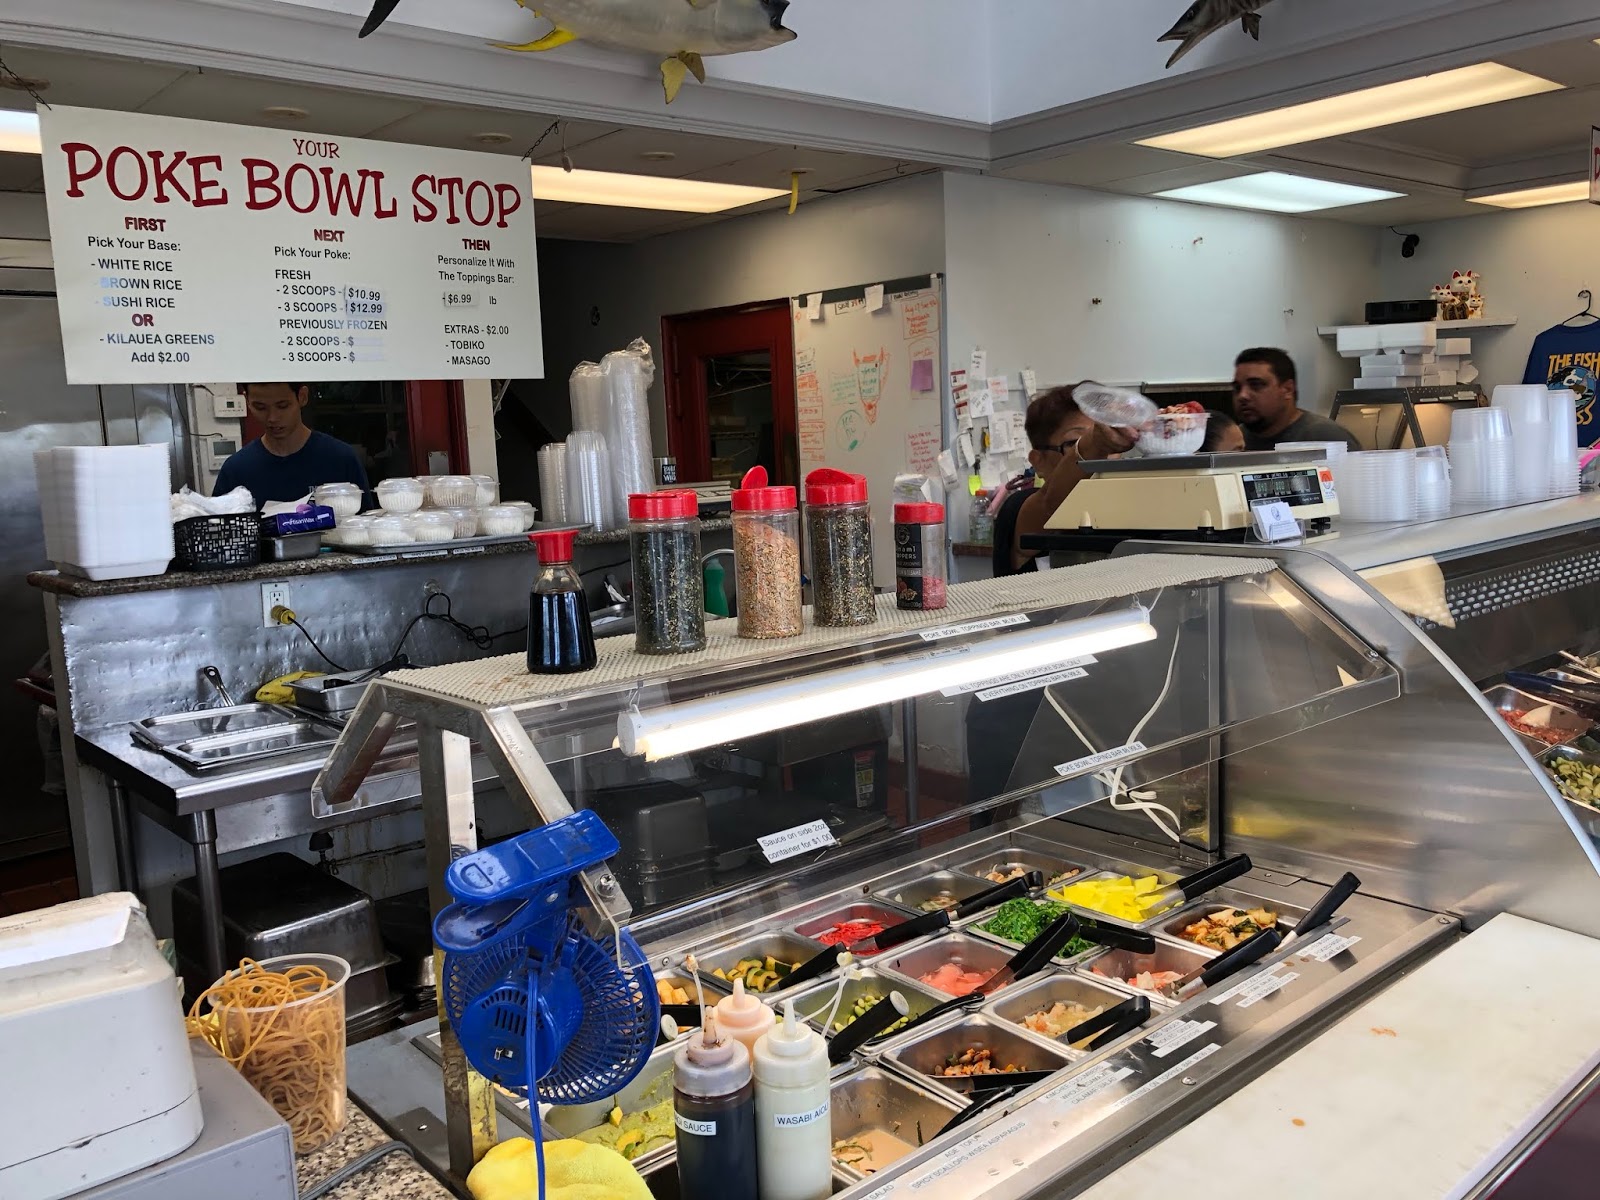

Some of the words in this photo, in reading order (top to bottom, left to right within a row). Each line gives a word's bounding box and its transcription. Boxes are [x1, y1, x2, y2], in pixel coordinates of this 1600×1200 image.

[293, 139, 340, 158] YOUR
[60, 142, 228, 207] POKE
[241, 158, 397, 219] BOWL
[411, 174, 521, 228] STOP
[124, 216, 166, 232] FIRST
[313, 229, 345, 242] NEXT
[88, 236, 114, 248] Pick
[117, 237, 144, 249] Your
[148, 239, 181, 251] Base:
[462, 238, 491, 251] THEN
[274, 246, 296, 257] Pick
[299, 247, 321, 258] Your
[324, 248, 351, 260] Poke:
[98, 258, 140, 270] WHITE
[143, 260, 173, 272] RICE
[437, 255, 487, 267] Personalize
[489, 258, 495, 267] It
[496, 258, 515, 268] With
[275, 269, 311, 280] FRESH
[438, 270, 455, 281] The
[457, 271, 496, 285] Toppings
[497, 274, 515, 284] Bar:
[153, 280, 183, 290] RICE
[283, 285, 289, 294] 2
[292, 285, 336, 296] SCOOPS
[348, 287, 381, 301] $10.99
[448, 293, 472, 306] $6.99
[489, 295, 497, 305] lb
[103, 296, 142, 307] SUSHI
[145, 297, 175, 308] RICE
[284, 302, 291, 312] 3
[293, 302, 337, 313] SCOOPS
[350, 302, 382, 314] $12.99
[131, 313, 154, 327] OR
[280, 319, 344, 329] PREVIOUSLY
[347, 320, 388, 330] FROZEN
[444, 324, 480, 334] EXTRAS
[486, 325, 509, 336] $2.00
[107, 333, 162, 344] KILAUEA
[165, 334, 215, 345] GREENS
[287, 336, 293, 346] 2
[296, 336, 340, 346] SCOOPS
[450, 340, 485, 350] TOBIKO
[131, 352, 155, 363] Add
[158, 351, 190, 364] $2.00
[288, 352, 295, 361] 3
[297, 352, 341, 362] SCOOPS
[452, 356, 491, 365] MASAGO
[1548, 353, 1573, 380] THE
[923, 629, 942, 639] POKE
[942, 627, 959, 637] BOWL
[989, 620, 1001, 628] BAR
[970, 677, 999, 689] TOPPINGS
[1011, 671, 1026, 680] ONLY
[1025, 668, 1038, 676] FOR
[1037, 665, 1053, 674] POKE
[982, 685, 1020, 699] EVERYTHING
[1050, 674, 1062, 682] BAR
[1057, 763, 1075, 774] POKE
[1074, 759, 1092, 769] BOWL
[761, 835, 787, 847] Sauce
[787, 832, 797, 840] on
[797, 827, 813, 837] side
[812, 823, 827, 832] 2oz
[768, 845, 801, 860] container
[800, 840, 812, 849] for
[811, 833, 833, 845] $1.00
[777, 1113, 812, 1125] WASABI
[683, 1121, 712, 1132] SAUCE
[911, 1175, 934, 1190] SPICY
[934, 1156, 969, 1177] SCALLOPS
[988, 1121, 1026, 1146] ASPARAGUS
[869, 1184, 895, 1200] SALAD
